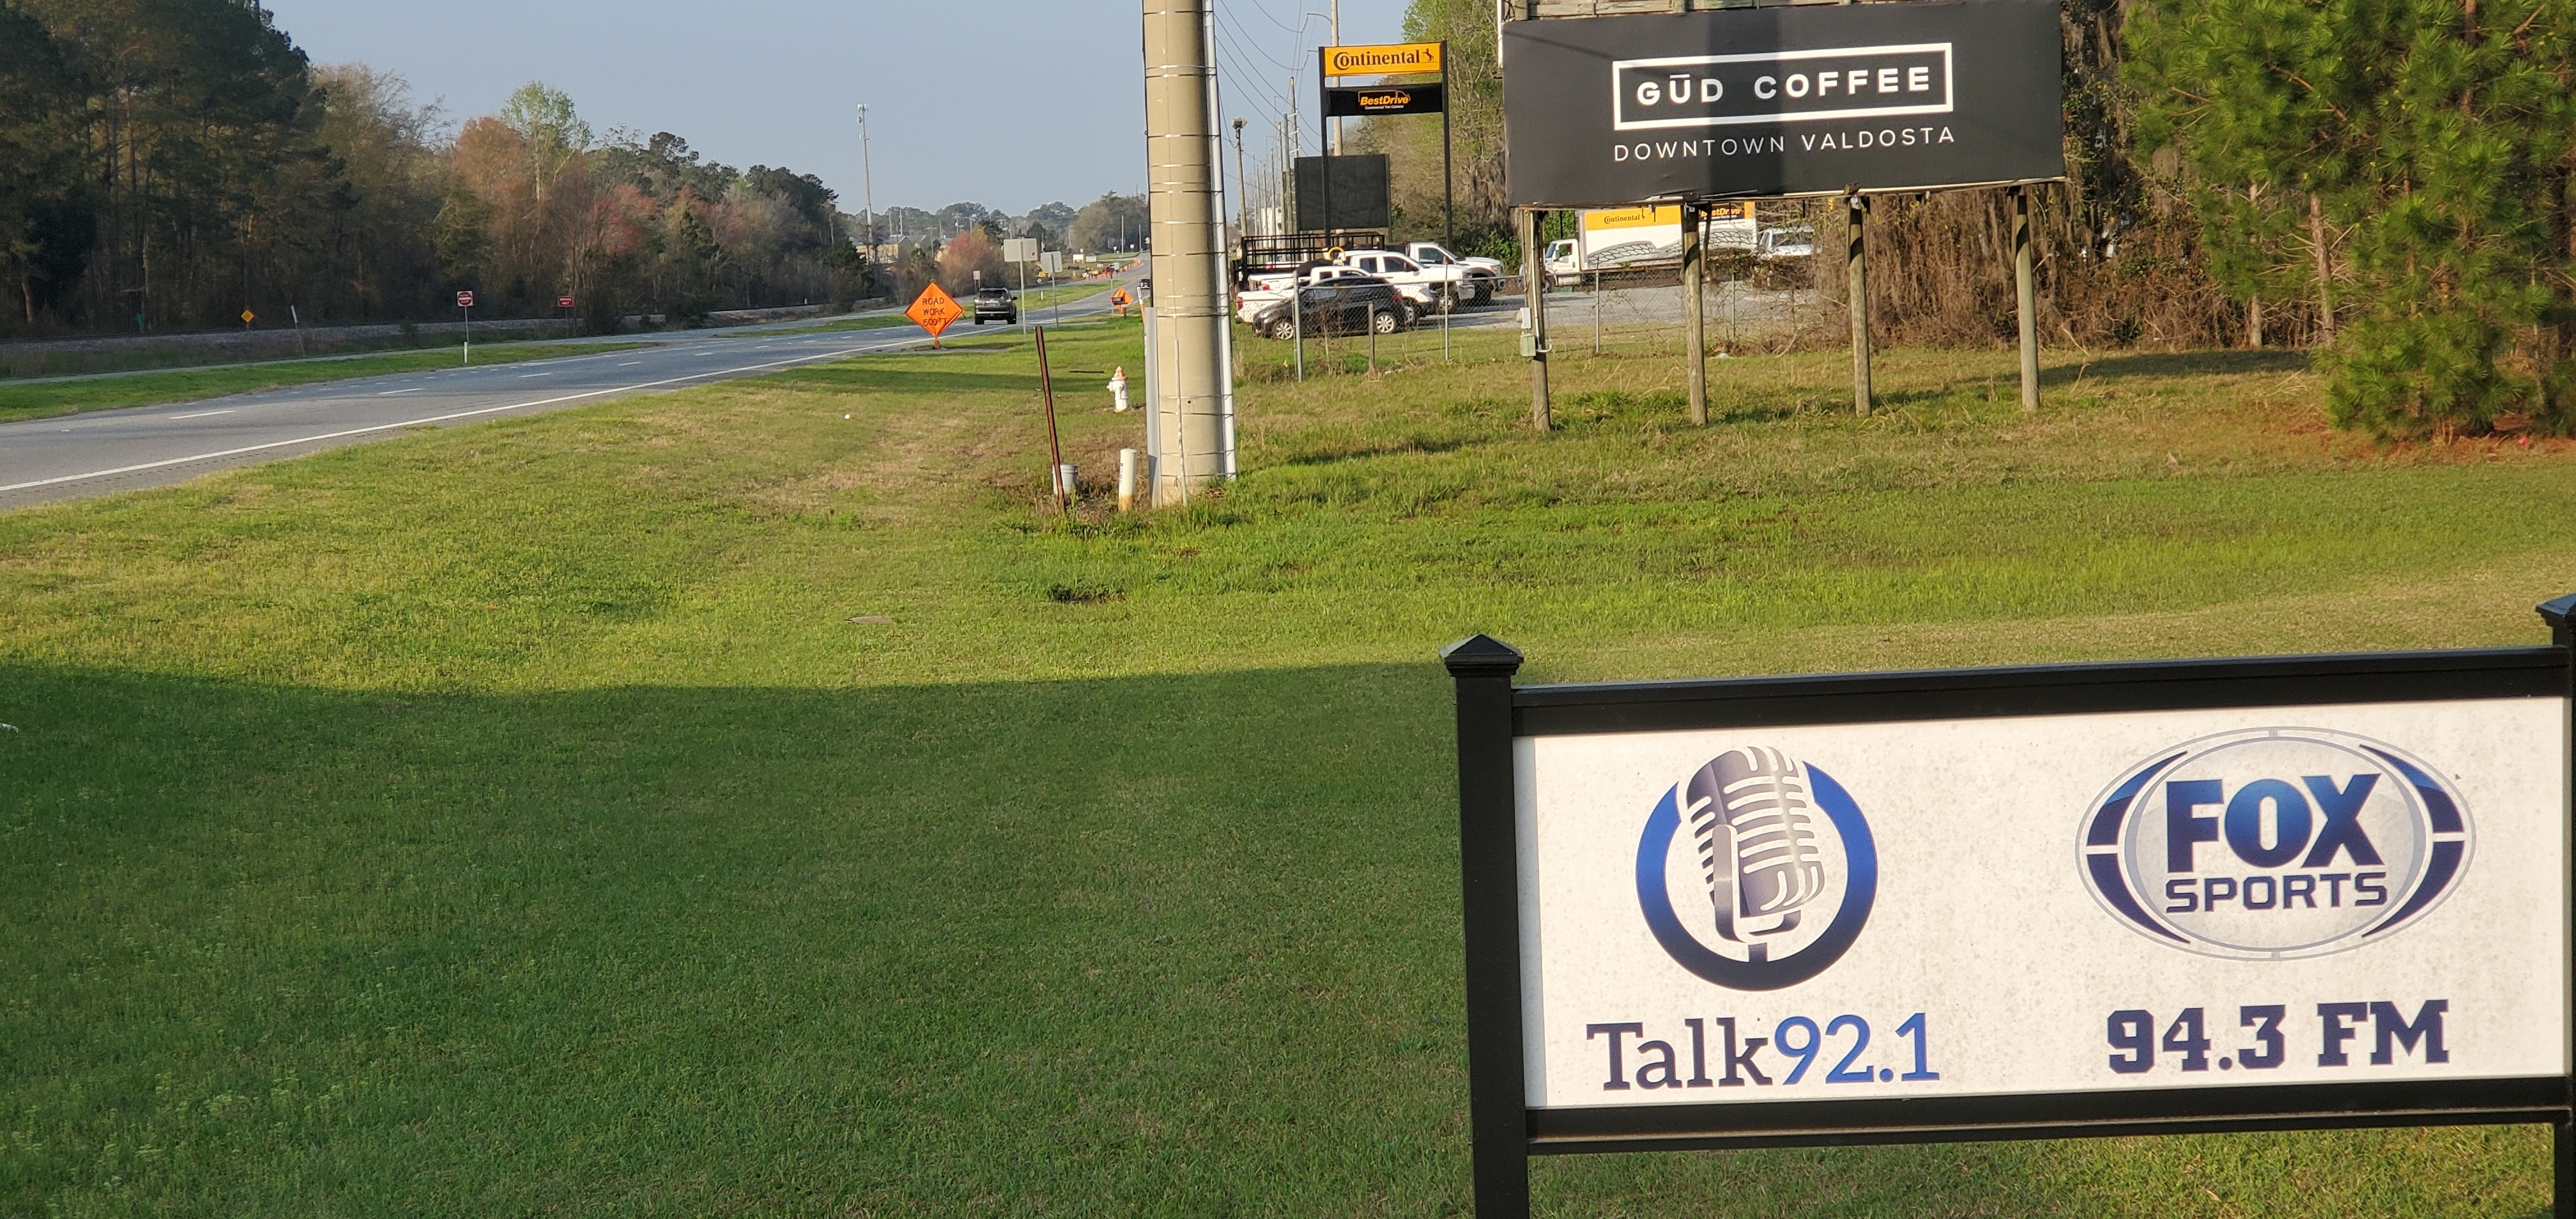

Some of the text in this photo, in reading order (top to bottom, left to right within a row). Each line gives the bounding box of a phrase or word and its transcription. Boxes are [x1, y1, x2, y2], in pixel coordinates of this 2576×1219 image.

[1333, 49, 1420, 70] Continental
[1360, 95, 1409, 105] BestDrive
[1637, 66, 1929, 105] GŪD COFFEE
[1614, 126, 1954, 161] DOWNTOWN VALDOSTA
[1604, 214, 1639, 224] Continental
[923, 297, 944, 305] ROAD
[923, 307, 944, 316] WORK
[2166, 773, 2384, 873] FOX
[2165, 871, 2388, 914] SPORTS
[1586, 1013, 1940, 1091] Talk92.1
[2107, 999, 2450, 1075] 94.3 FM
